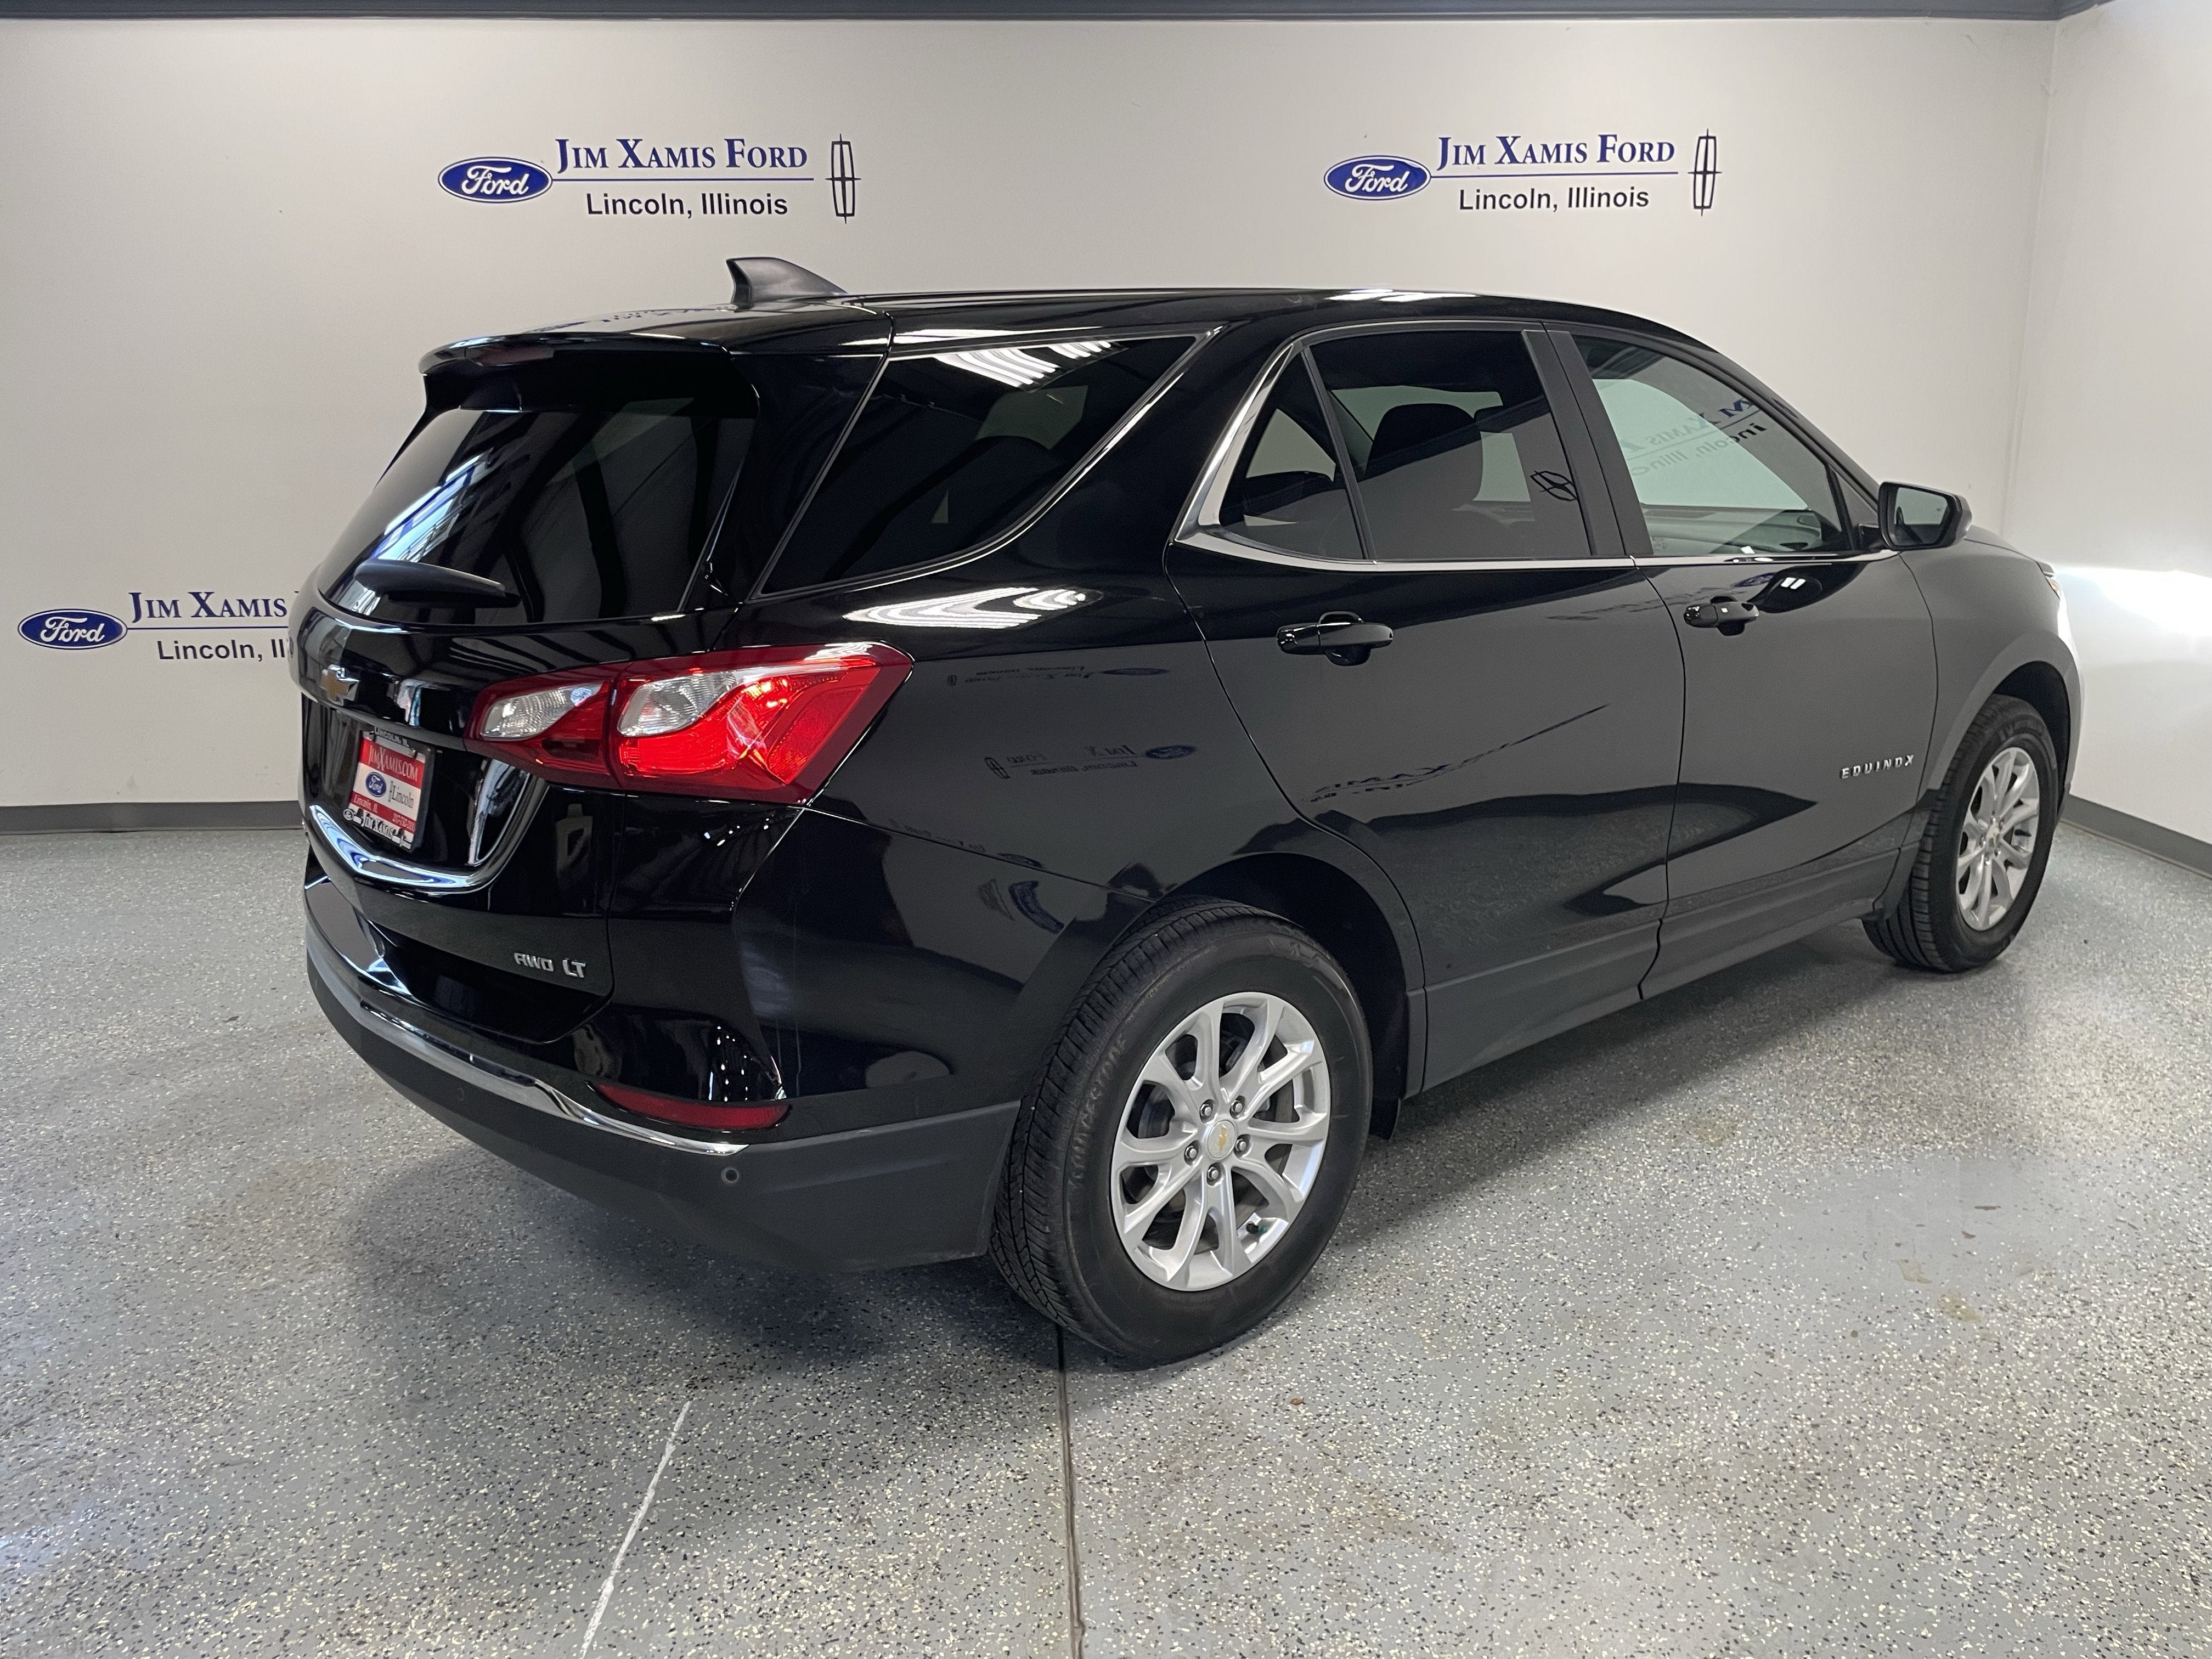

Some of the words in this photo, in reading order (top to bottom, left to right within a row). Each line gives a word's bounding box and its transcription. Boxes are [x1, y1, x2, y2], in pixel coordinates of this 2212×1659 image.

[555, 138, 607, 174] JIM
[616, 138, 714, 169] XAMIS
[724, 138, 808, 169] FORD
[1436, 136, 1487, 171] JIM
[1494, 135, 1588, 166] XAMIS
[1598, 133, 1675, 165] FORD
[461, 165, 531, 196] Ford
[1344, 163, 1409, 194] Ford
[586, 193, 693, 219] Lincoln,
[702, 193, 788, 216] Illinois
[1459, 188, 1558, 213] Lincoln,
[1567, 186, 1650, 209] Illinois
[128, 591, 182, 623] JIM
[188, 591, 287, 618] XAMIS
[40, 616, 105, 643] Ford
[157, 640, 263, 662] Lincoln,
[1841, 754, 1914, 779] EQUINOX
[391, 785, 414, 809] Lincoln
[514, 952, 554, 972] AWD
[562, 957, 586, 978] LT
